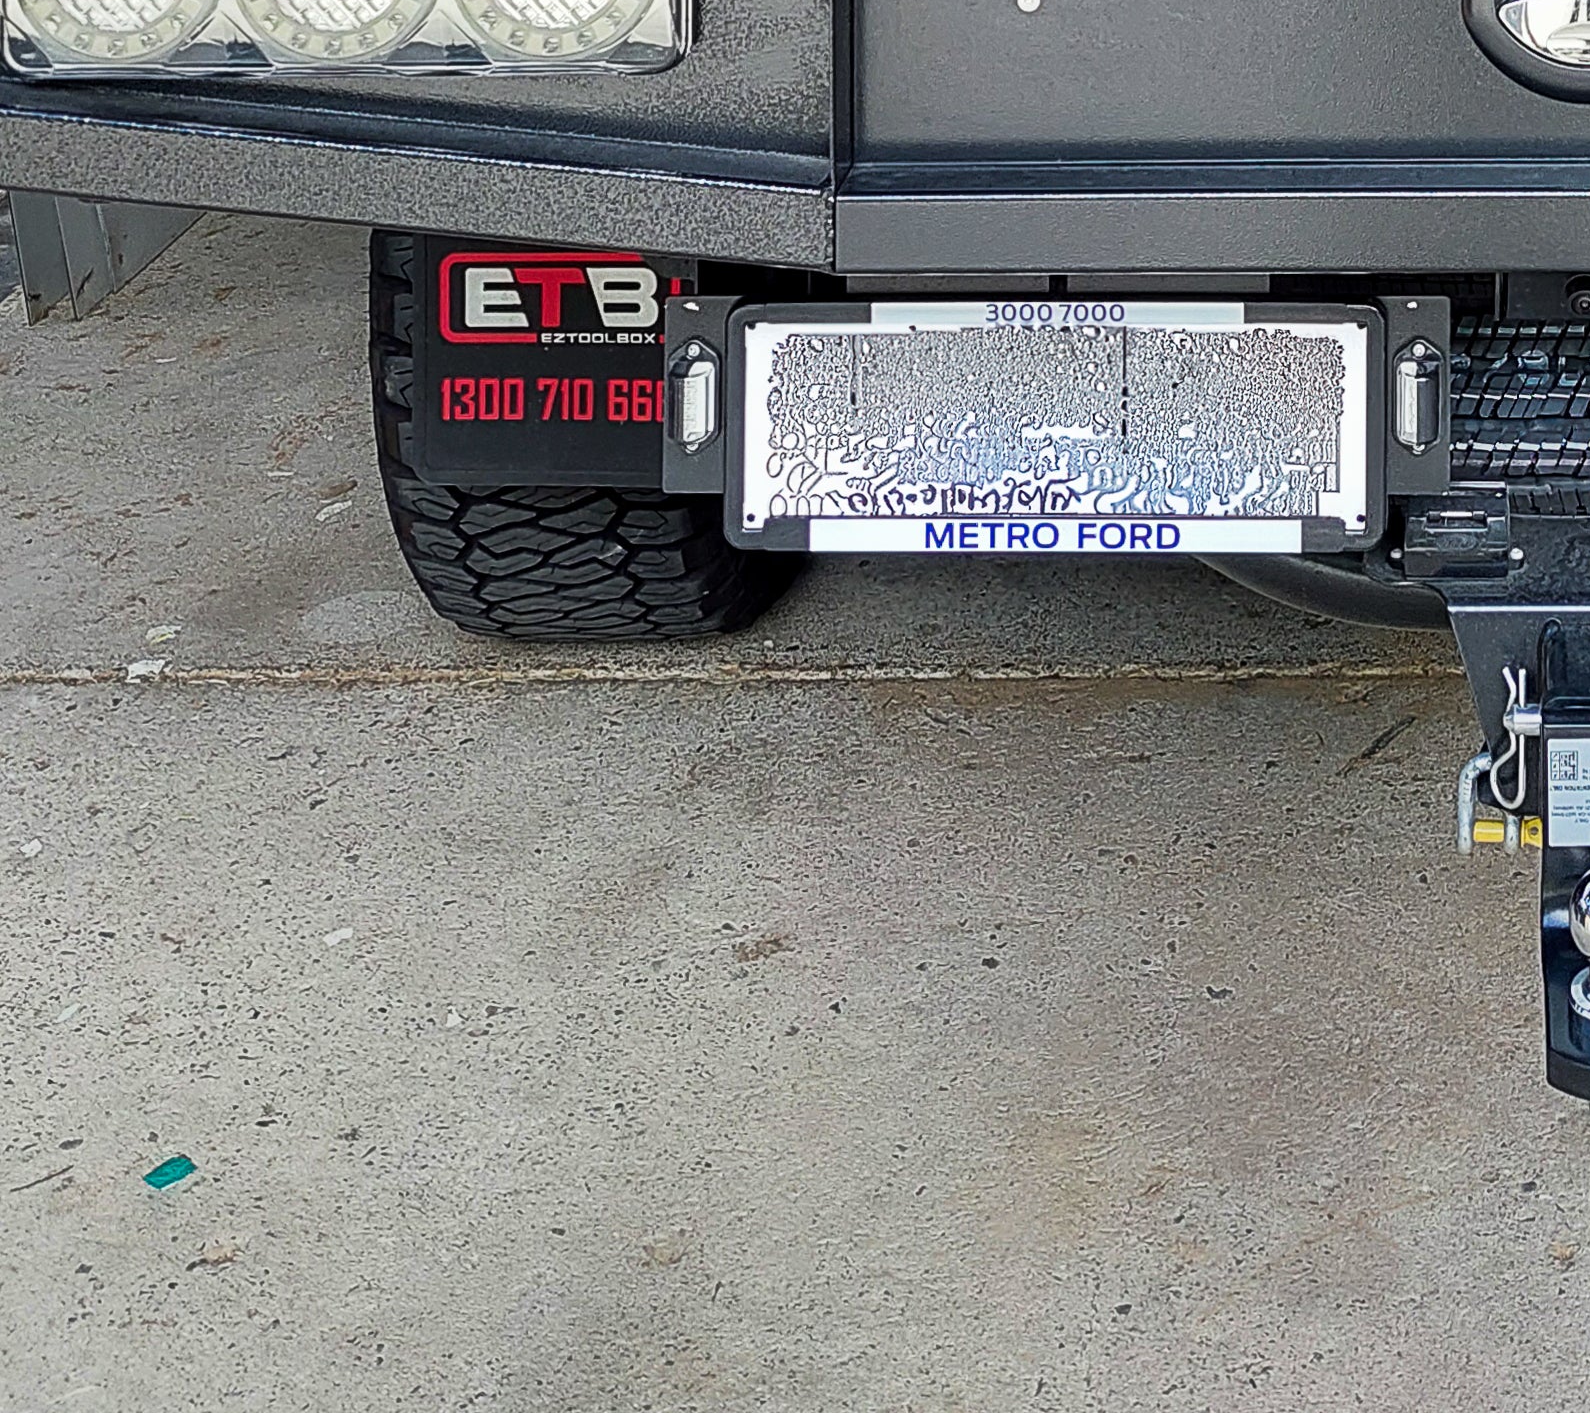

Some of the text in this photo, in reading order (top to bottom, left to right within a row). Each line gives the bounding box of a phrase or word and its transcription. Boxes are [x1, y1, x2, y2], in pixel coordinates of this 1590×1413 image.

[465, 267, 659, 327] ETB
[985, 303, 1125, 323] 3000 7000
[541, 333, 656, 344] EZTOOLBOX
[440, 378, 525, 421] 1300
[536, 378, 595, 421] 710
[925, 523, 1181, 549] METRO FORD
